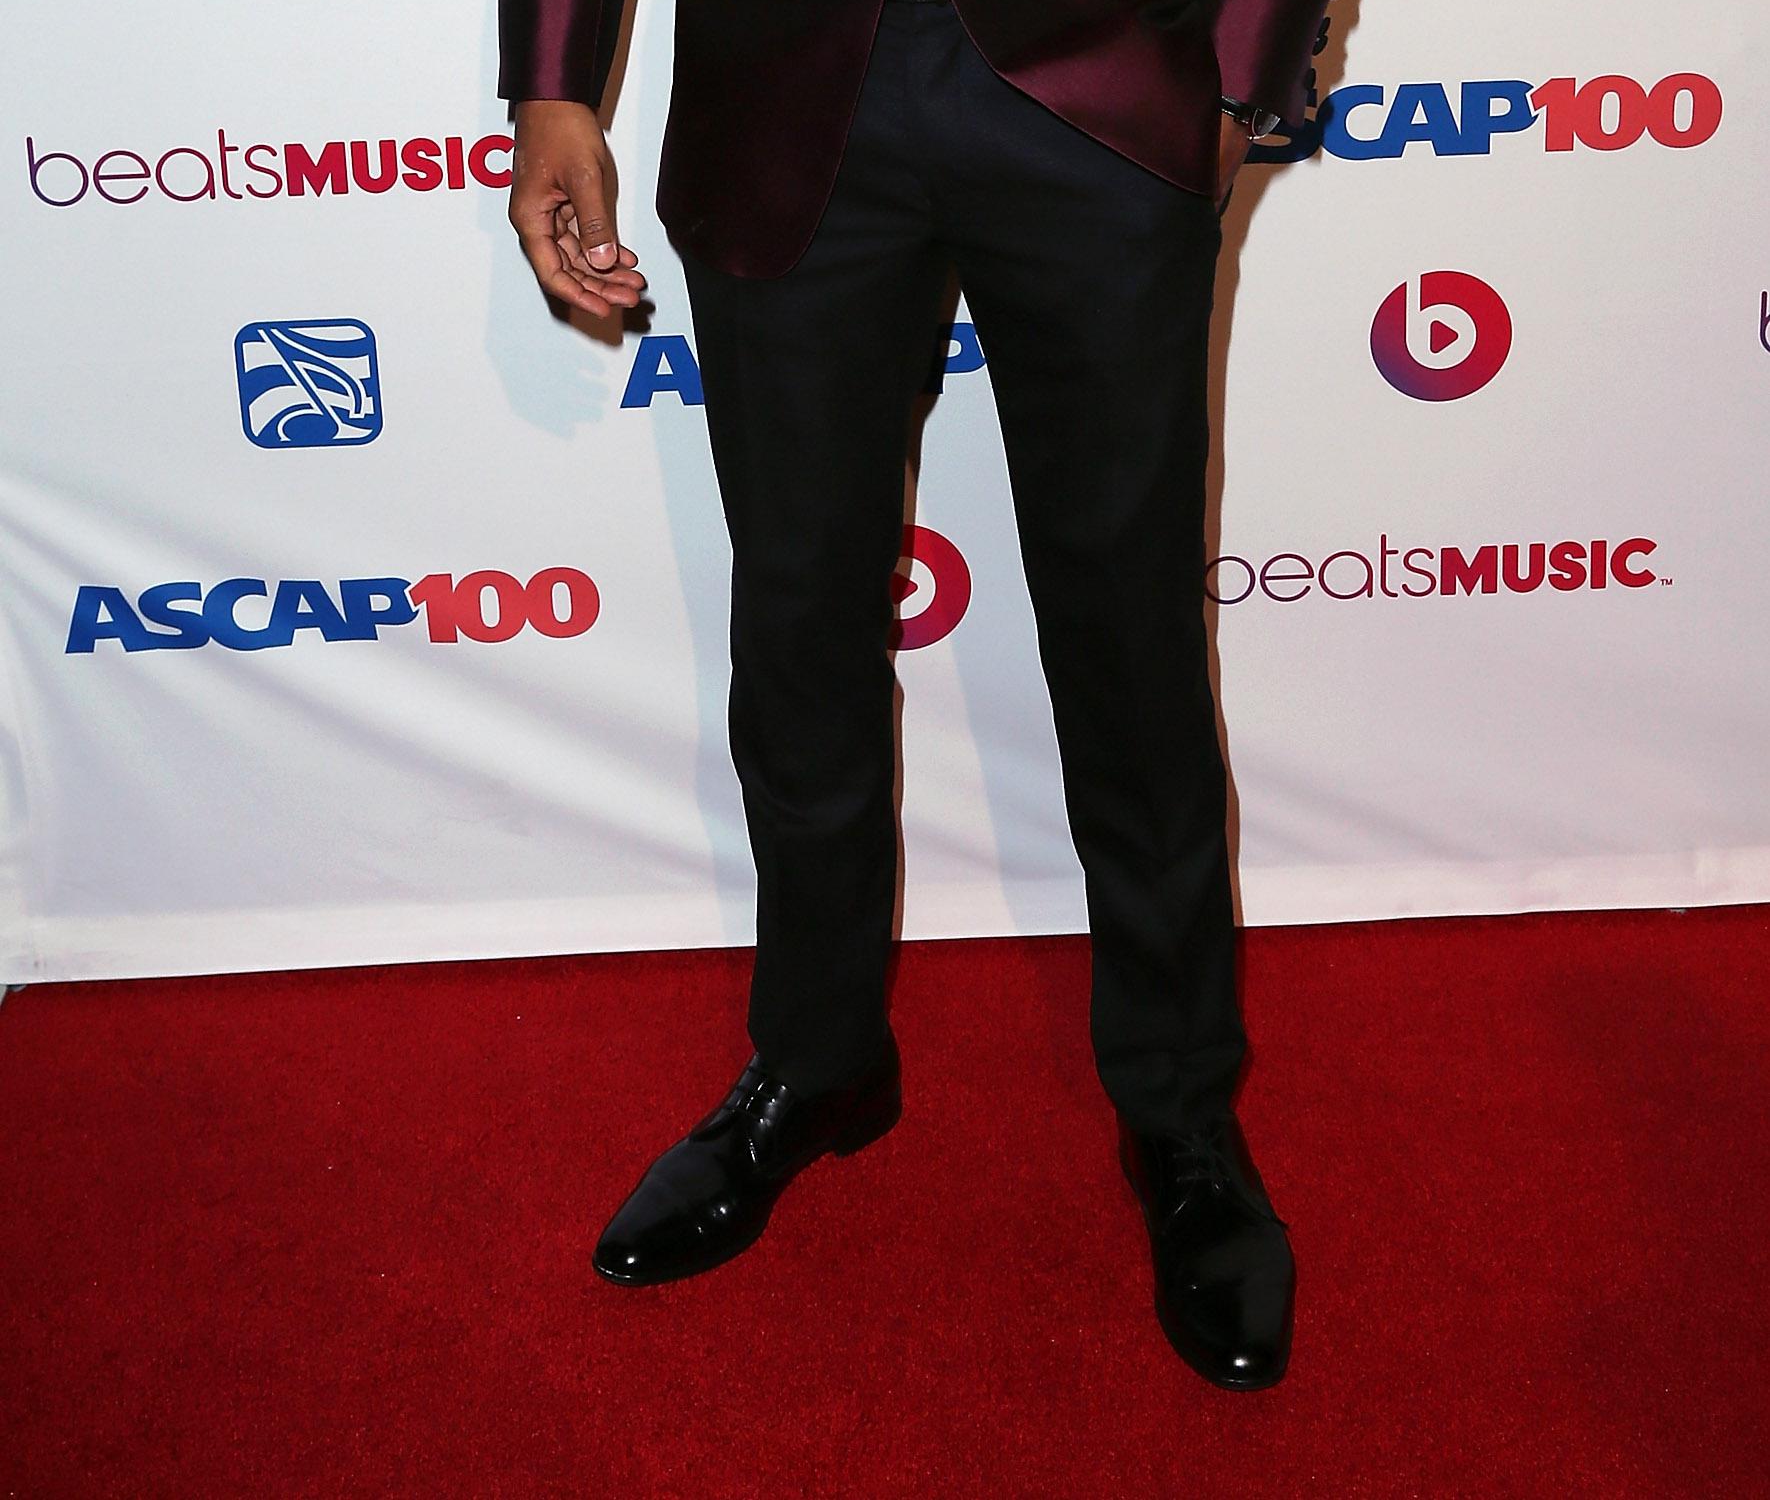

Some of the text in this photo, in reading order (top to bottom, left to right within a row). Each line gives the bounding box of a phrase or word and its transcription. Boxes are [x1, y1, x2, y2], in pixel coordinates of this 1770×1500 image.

[1243, 73, 1723, 164] CAP100
[26, 129, 515, 207] beatsMUSIC
[65, 567, 600, 654] ASCAP100
